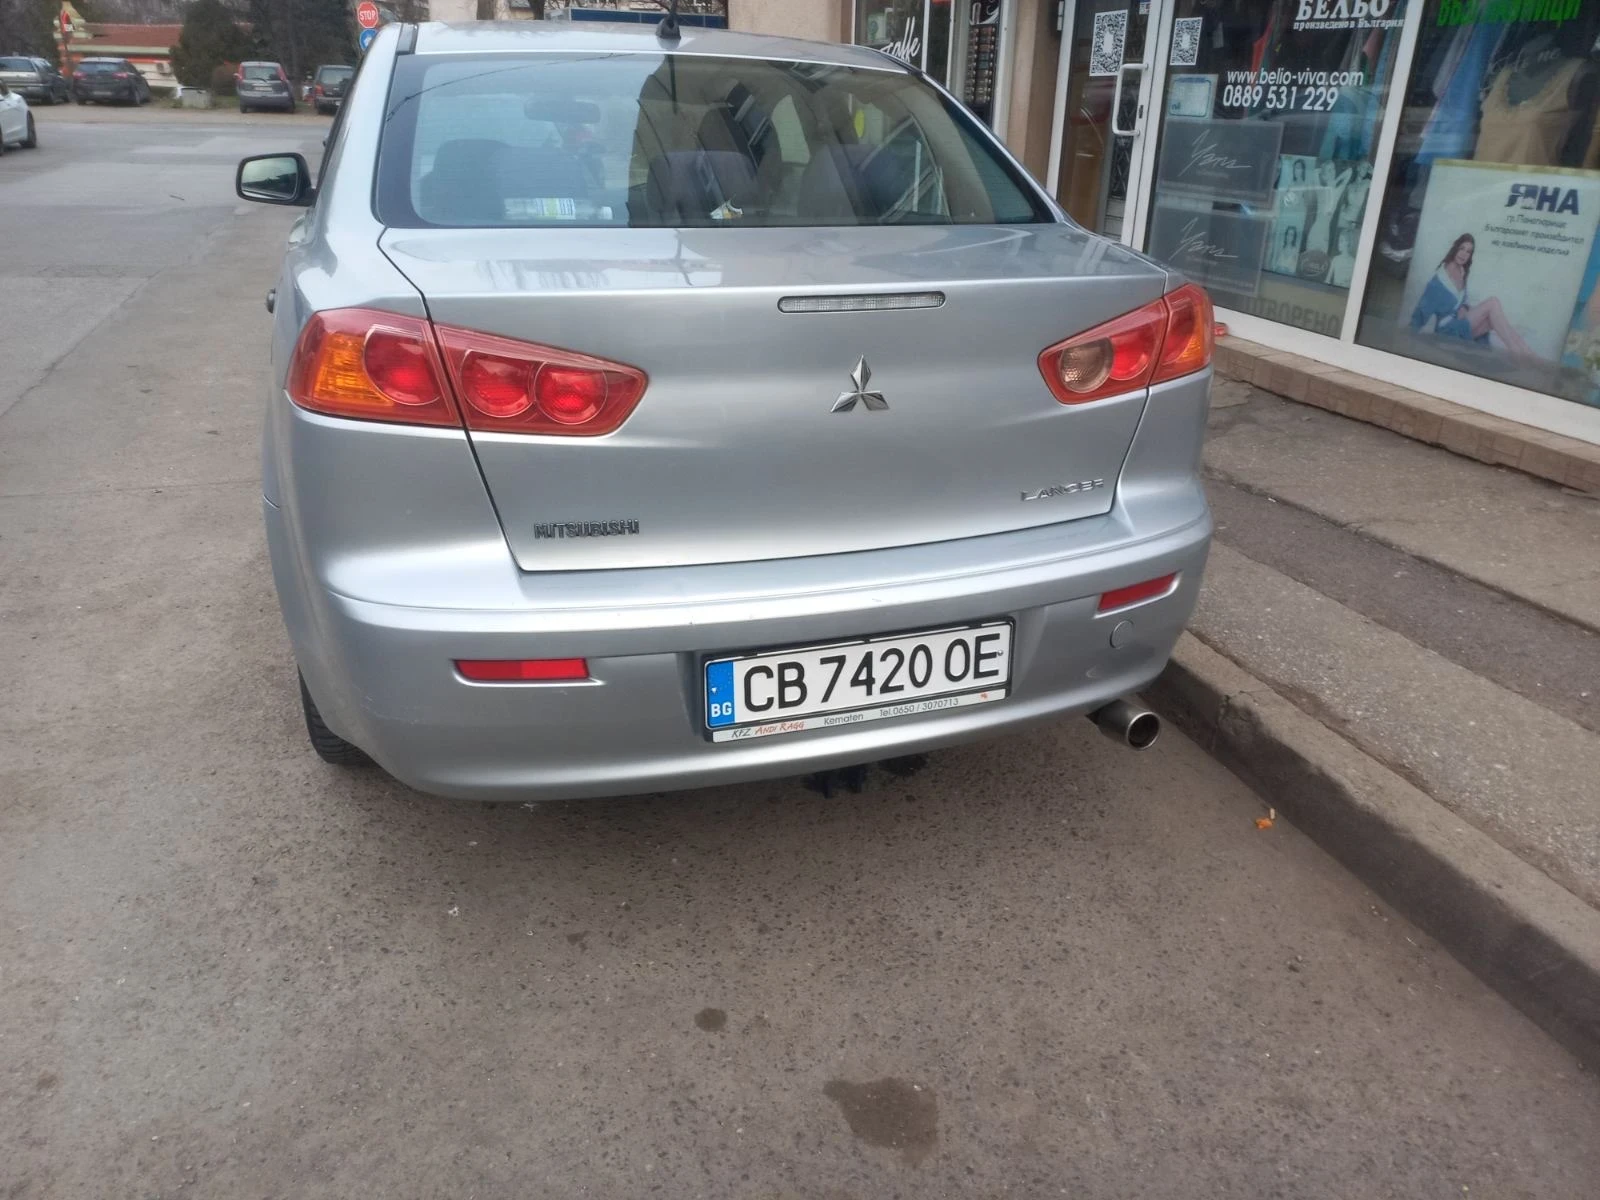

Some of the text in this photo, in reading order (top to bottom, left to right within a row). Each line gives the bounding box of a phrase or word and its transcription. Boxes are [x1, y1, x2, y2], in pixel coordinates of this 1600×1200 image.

[360, 10, 376, 20] STOP
[1293, 20, 1349, 31] произведено
[1227, 68, 1364, 87] www.belio-viva.com
[1223, 85, 1262, 107] 0889
[1266, 86, 1297, 109] 531
[1302, 87, 1338, 111] 229
[1020, 478, 1104, 501] LANCER
[533, 519, 640, 539] MITSUBISHI
[744, 633, 1000, 712] CB 7420 OE
[711, 702, 732, 717] BG
[823, 713, 864, 726] Kematen
[922, 697, 959, 711] 3070713
